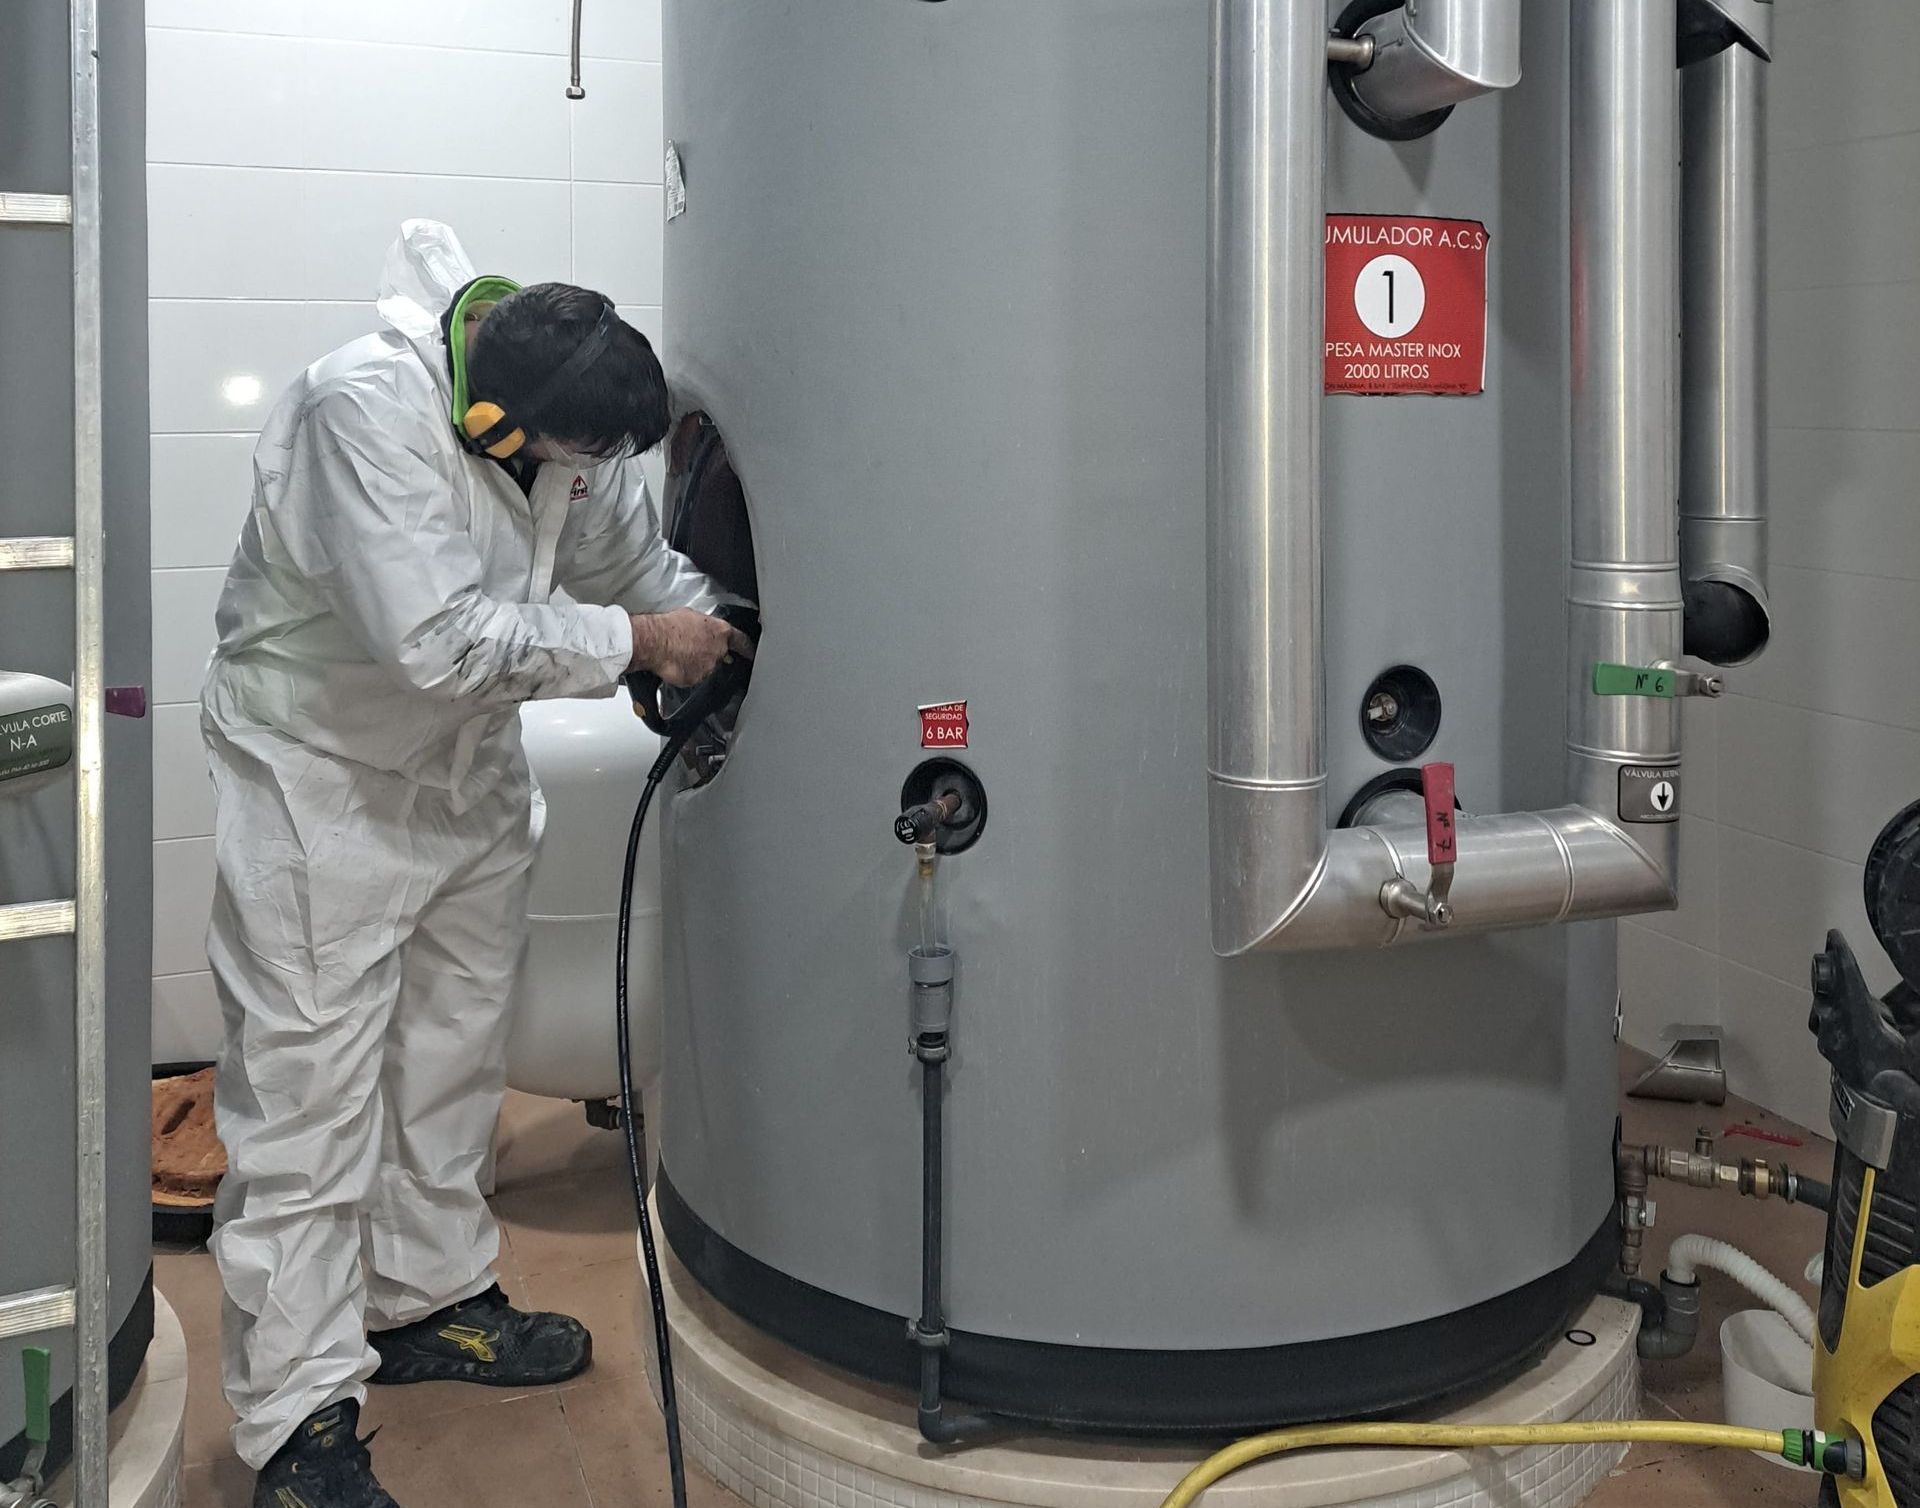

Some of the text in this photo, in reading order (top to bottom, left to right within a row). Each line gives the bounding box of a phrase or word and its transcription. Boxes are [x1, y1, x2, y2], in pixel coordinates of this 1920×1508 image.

[1382, 270, 1394, 324] 1
[1325, 343, 1461, 358] PESA MASTER INOX
[1344, 363, 1430, 379] 2000 LITROS
[1655, 677, 1664, 692] 6
[32, 710, 67, 728] CORTE
[925, 712, 963, 720] SEGURIDAD
[926, 727, 963, 740] 6 BAR
[10, 733, 37, 752] N-A
